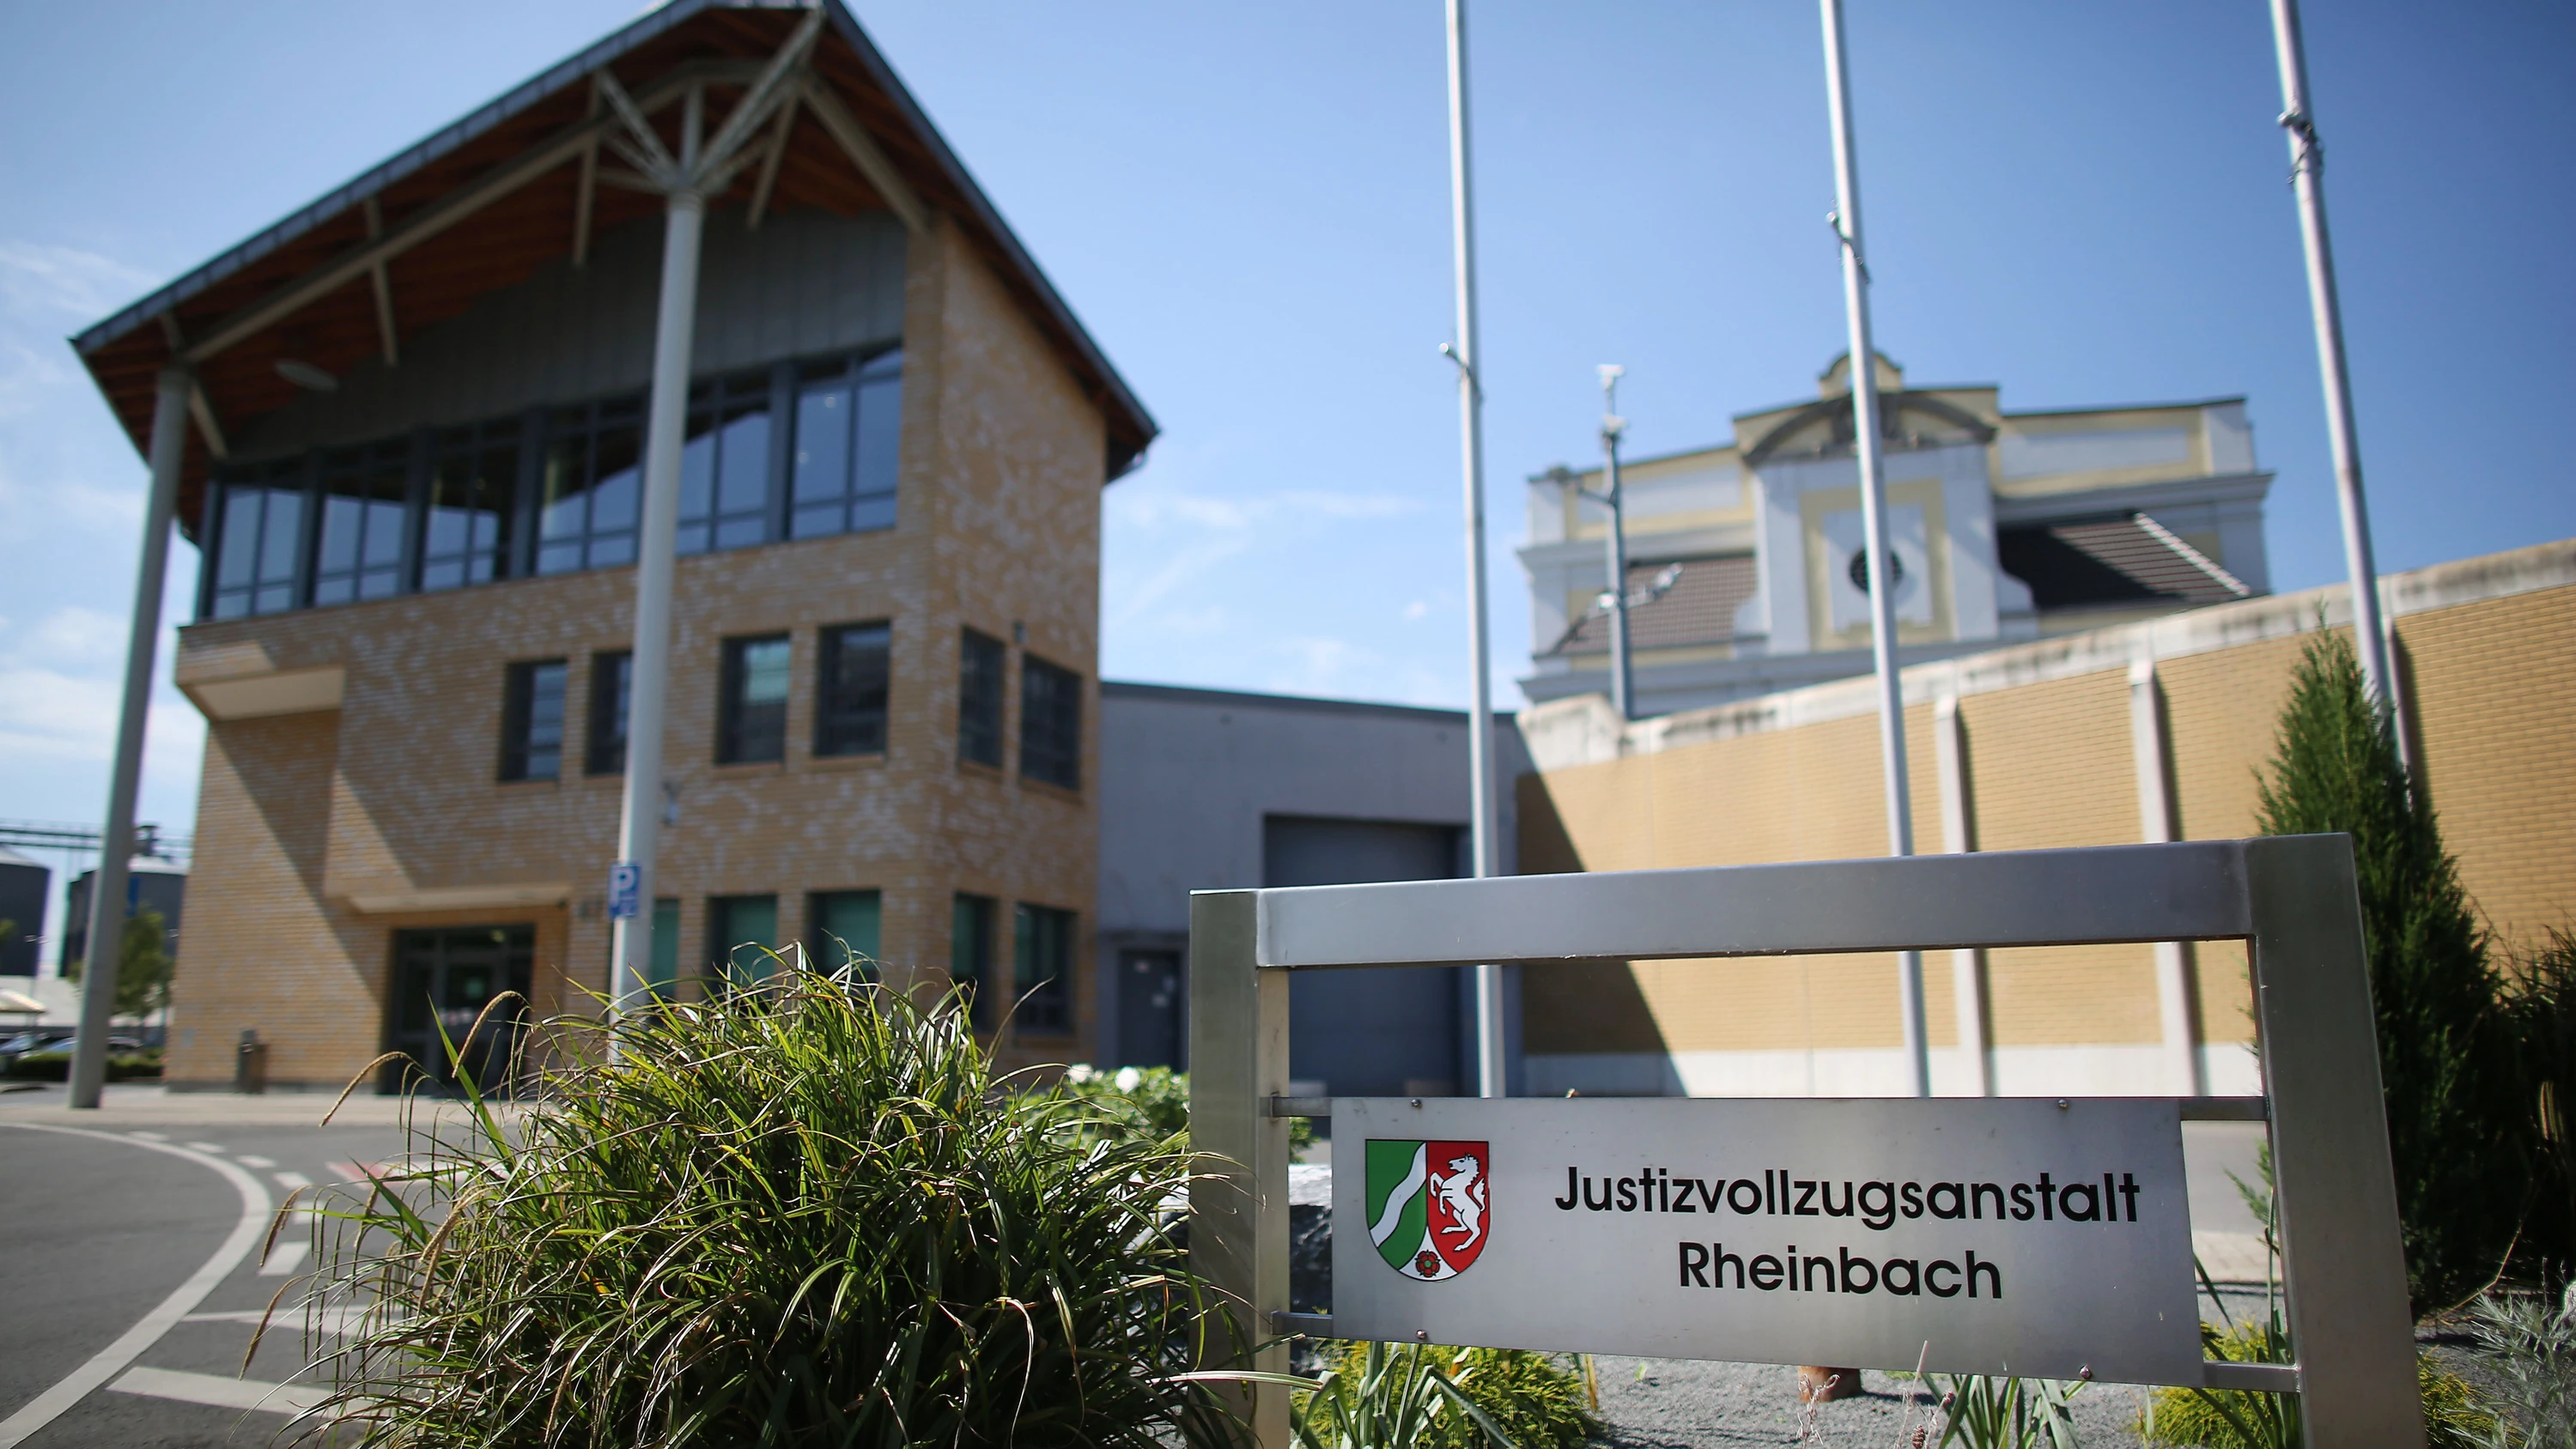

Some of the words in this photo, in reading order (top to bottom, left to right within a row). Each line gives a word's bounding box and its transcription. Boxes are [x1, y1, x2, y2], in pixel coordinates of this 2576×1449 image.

[609, 867, 635, 907] P
[1555, 1166, 2141, 1229] Justizvollzugsanstalt
[1678, 1241, 2002, 1299] Rheinbach
